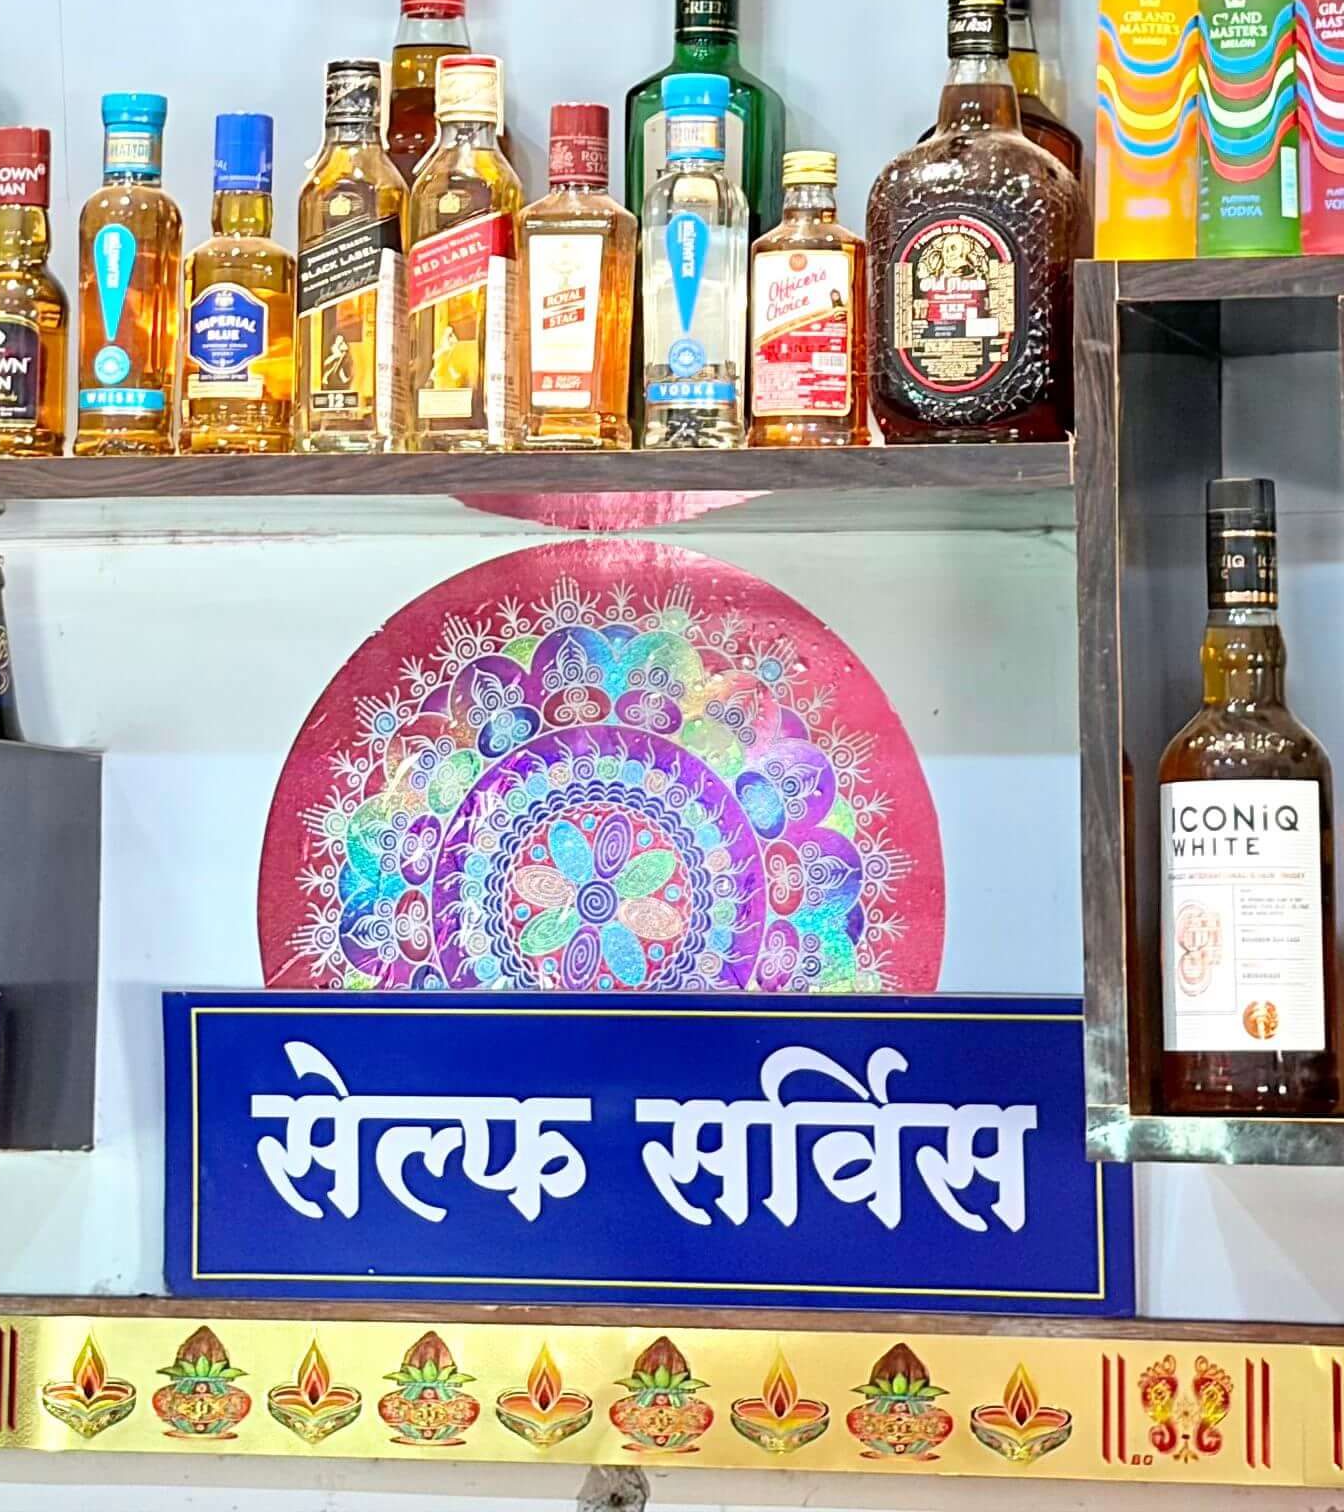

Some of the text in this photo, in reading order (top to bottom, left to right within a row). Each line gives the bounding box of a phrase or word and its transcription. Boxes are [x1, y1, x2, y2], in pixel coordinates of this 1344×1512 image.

[1123, 11, 1175, 24] GRAND
[1119, 23, 1182, 37] MASTER'S
[1209, 25, 1268, 39] MASTER'S
[1220, 39, 1256, 49] MELON
[1220, 206, 1264, 217] VODKA
[301, 258, 339, 282] BLACK
[414, 257, 442, 276] RED
[768, 269, 827, 301] Officer's
[547, 290, 582, 307] ROYAL
[766, 295, 810, 322] Choice
[195, 315, 256, 334] IMPERIAL
[549, 309, 578, 328] STAG
[207, 328, 240, 342] BLUE
[660, 383, 715, 396] VODKA
[86, 393, 146, 405] WHISKY
[327, 394, 345, 409] 12
[1173, 836, 1260, 857] WHITE
[251, 1041, 1038, 1234] सेल्फ सर्विस
